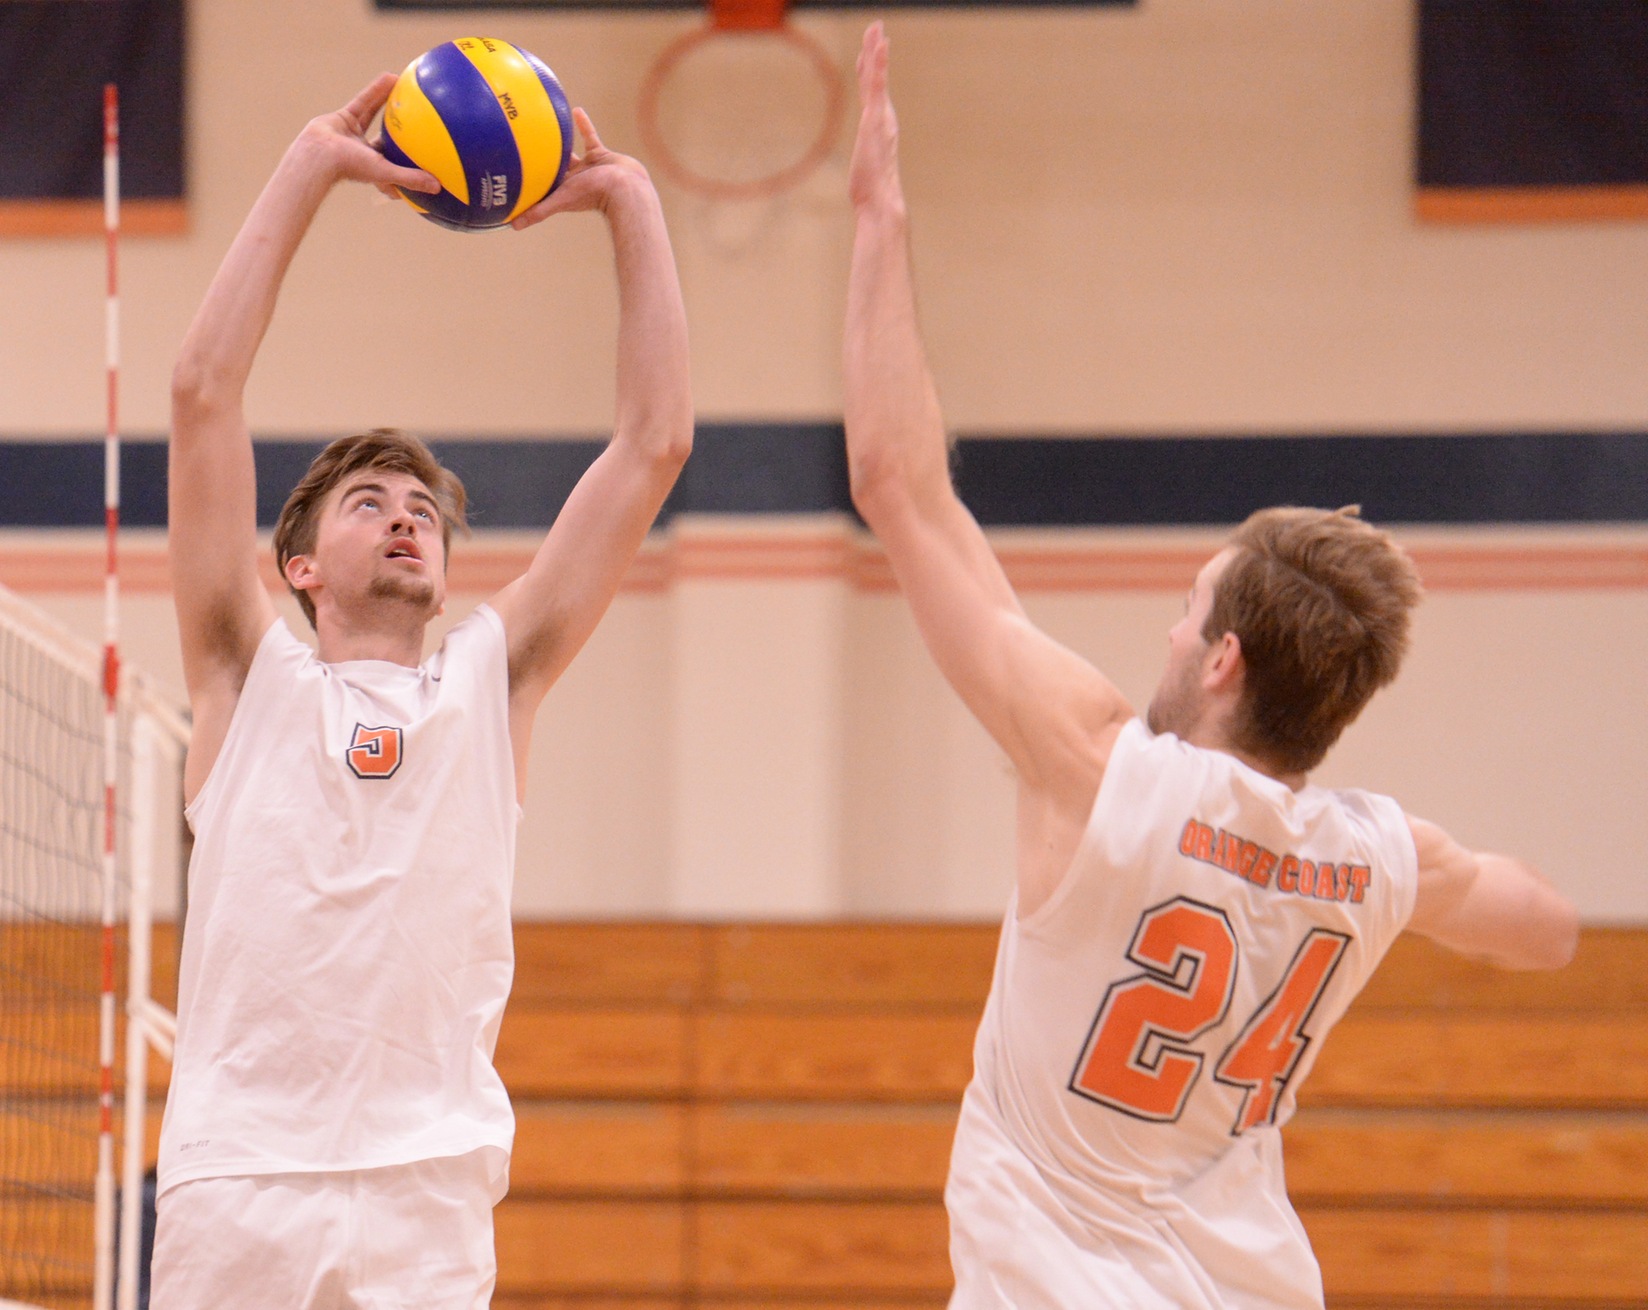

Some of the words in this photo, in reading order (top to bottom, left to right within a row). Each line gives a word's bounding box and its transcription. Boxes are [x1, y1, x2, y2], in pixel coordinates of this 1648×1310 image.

[498, 92, 518, 121] MVB
[493, 174, 507, 206] FIVB
[1179, 818, 1277, 888] ORANGE
[1277, 854, 1371, 903] COAST
[1067, 895, 1354, 1137] 24
